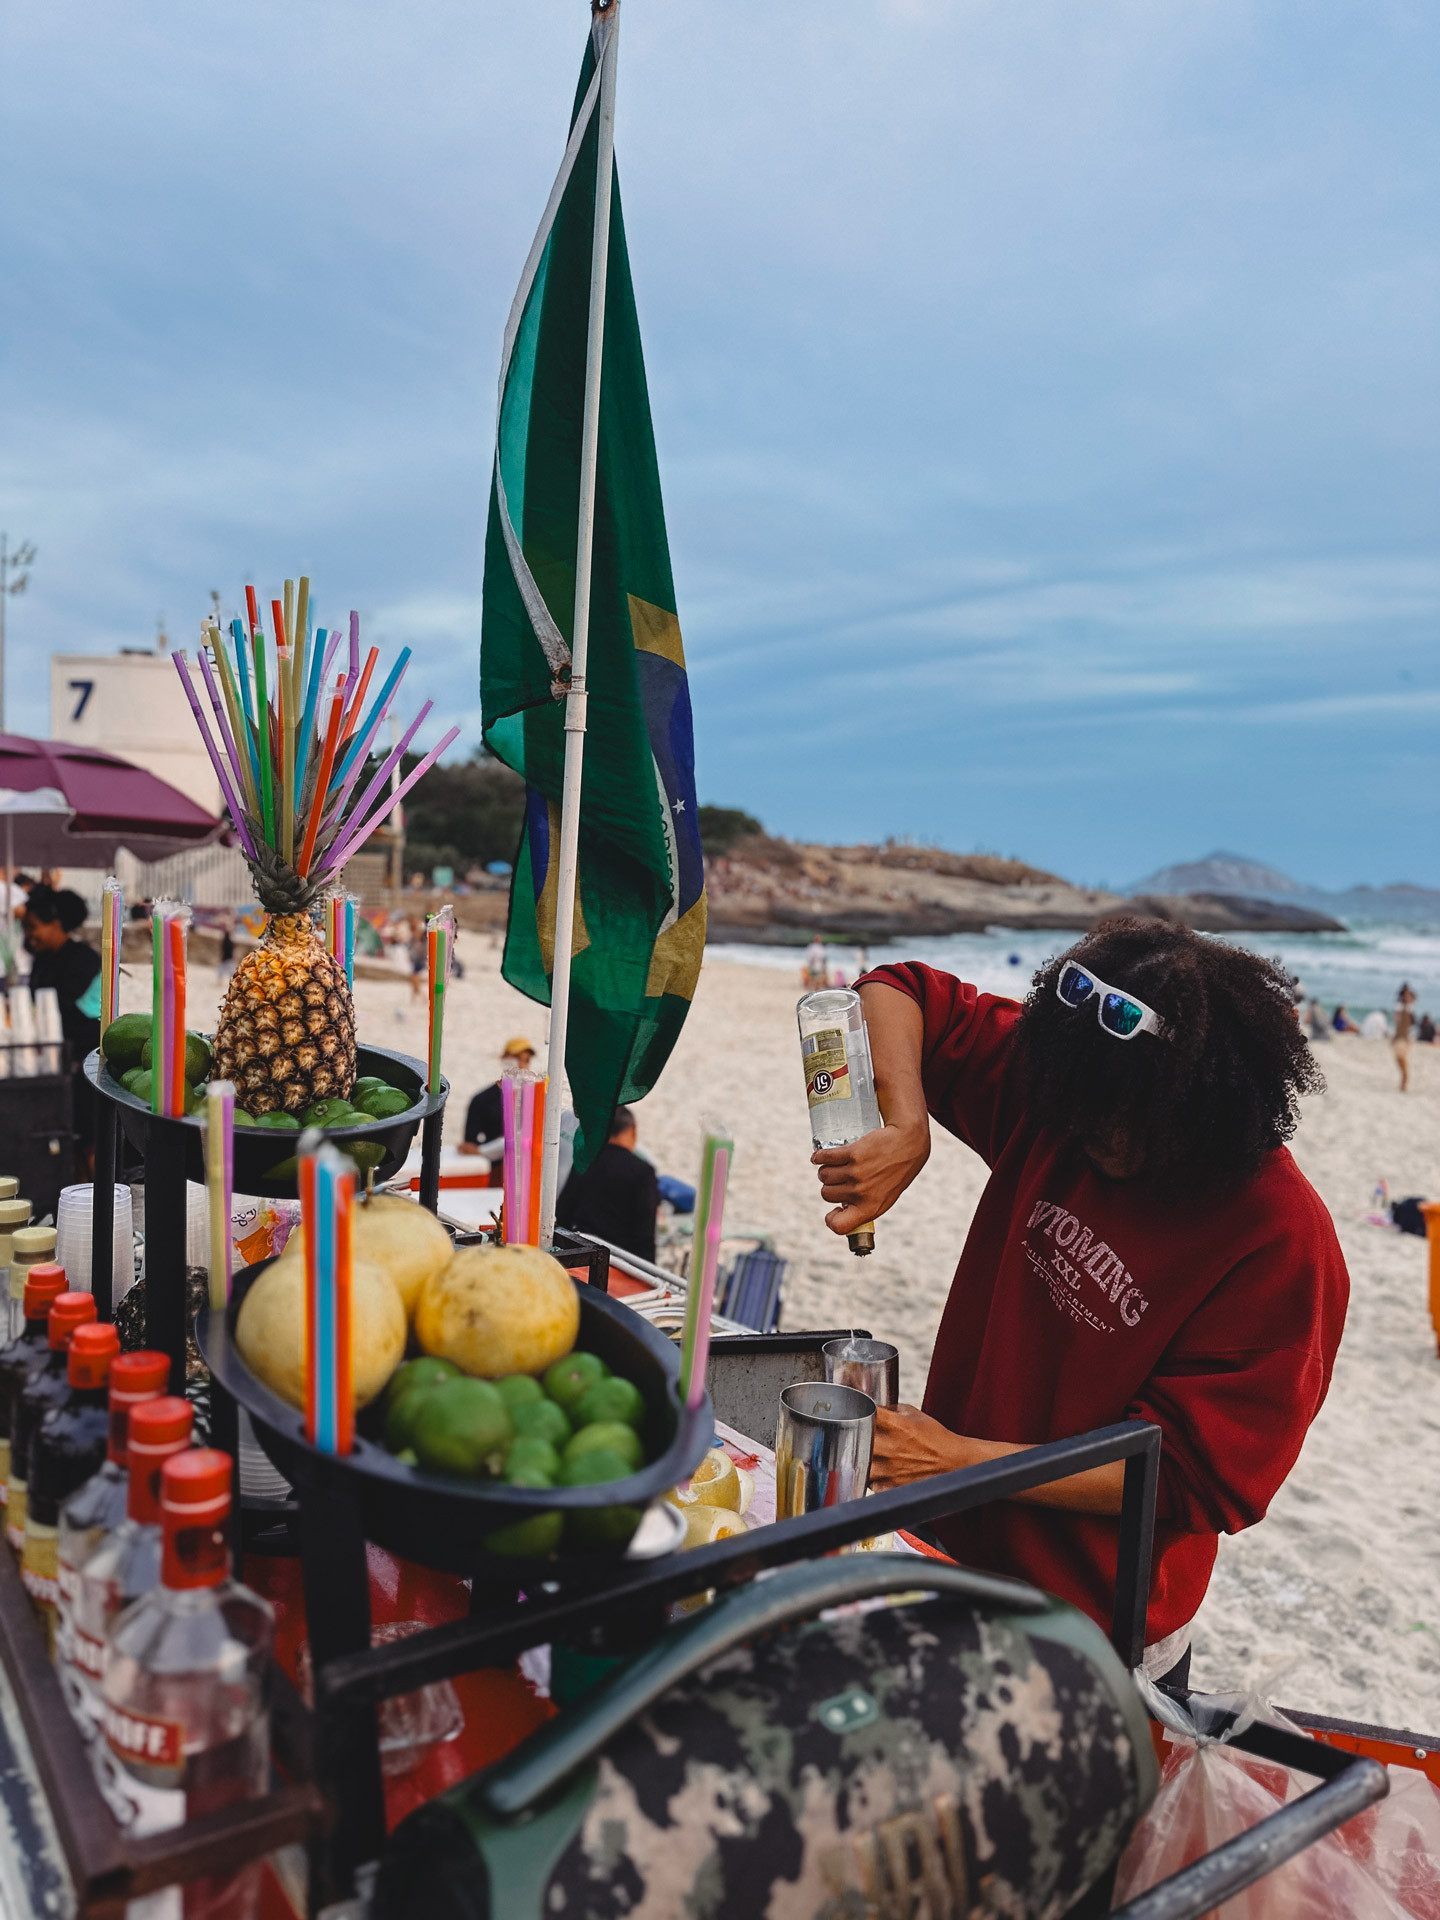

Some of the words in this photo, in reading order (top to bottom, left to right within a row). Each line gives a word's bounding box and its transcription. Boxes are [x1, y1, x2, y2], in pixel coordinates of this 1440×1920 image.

[69, 680, 94, 722] 7
[816, 1074, 829, 1090] 51
[1021, 1240, 1053, 1276] AHLETIC
[1026, 1200, 1149, 1327] WYOMING
[1051, 1249, 1081, 1291] XXL
[1033, 1266, 1081, 1323] ESTABLISED
